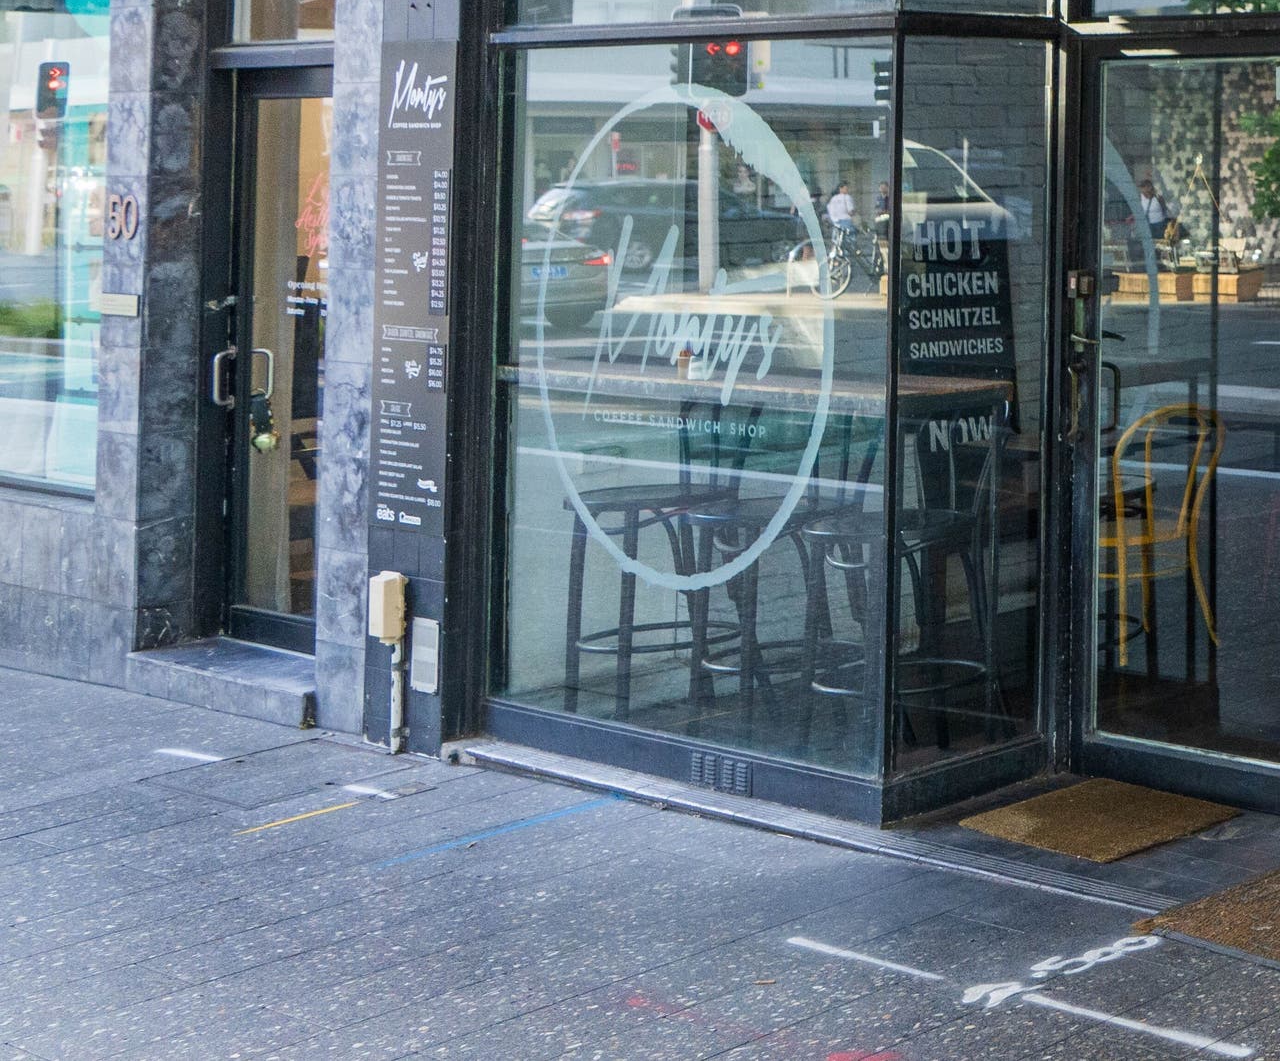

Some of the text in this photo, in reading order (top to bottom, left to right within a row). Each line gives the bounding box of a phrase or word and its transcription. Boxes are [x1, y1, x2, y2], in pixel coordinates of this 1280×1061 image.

[388, 59, 448, 128] Montys
[109, 194, 138, 241] 50
[912, 220, 986, 261] HOT
[906, 271, 999, 298] CHICKEN
[909, 307, 1000, 330] SCHNITZEL
[910, 338, 1004, 360] SANDWICHES
[594, 409, 766, 439] COFFEE SANDWICH SHOP
[377, 508, 395, 521] eats
